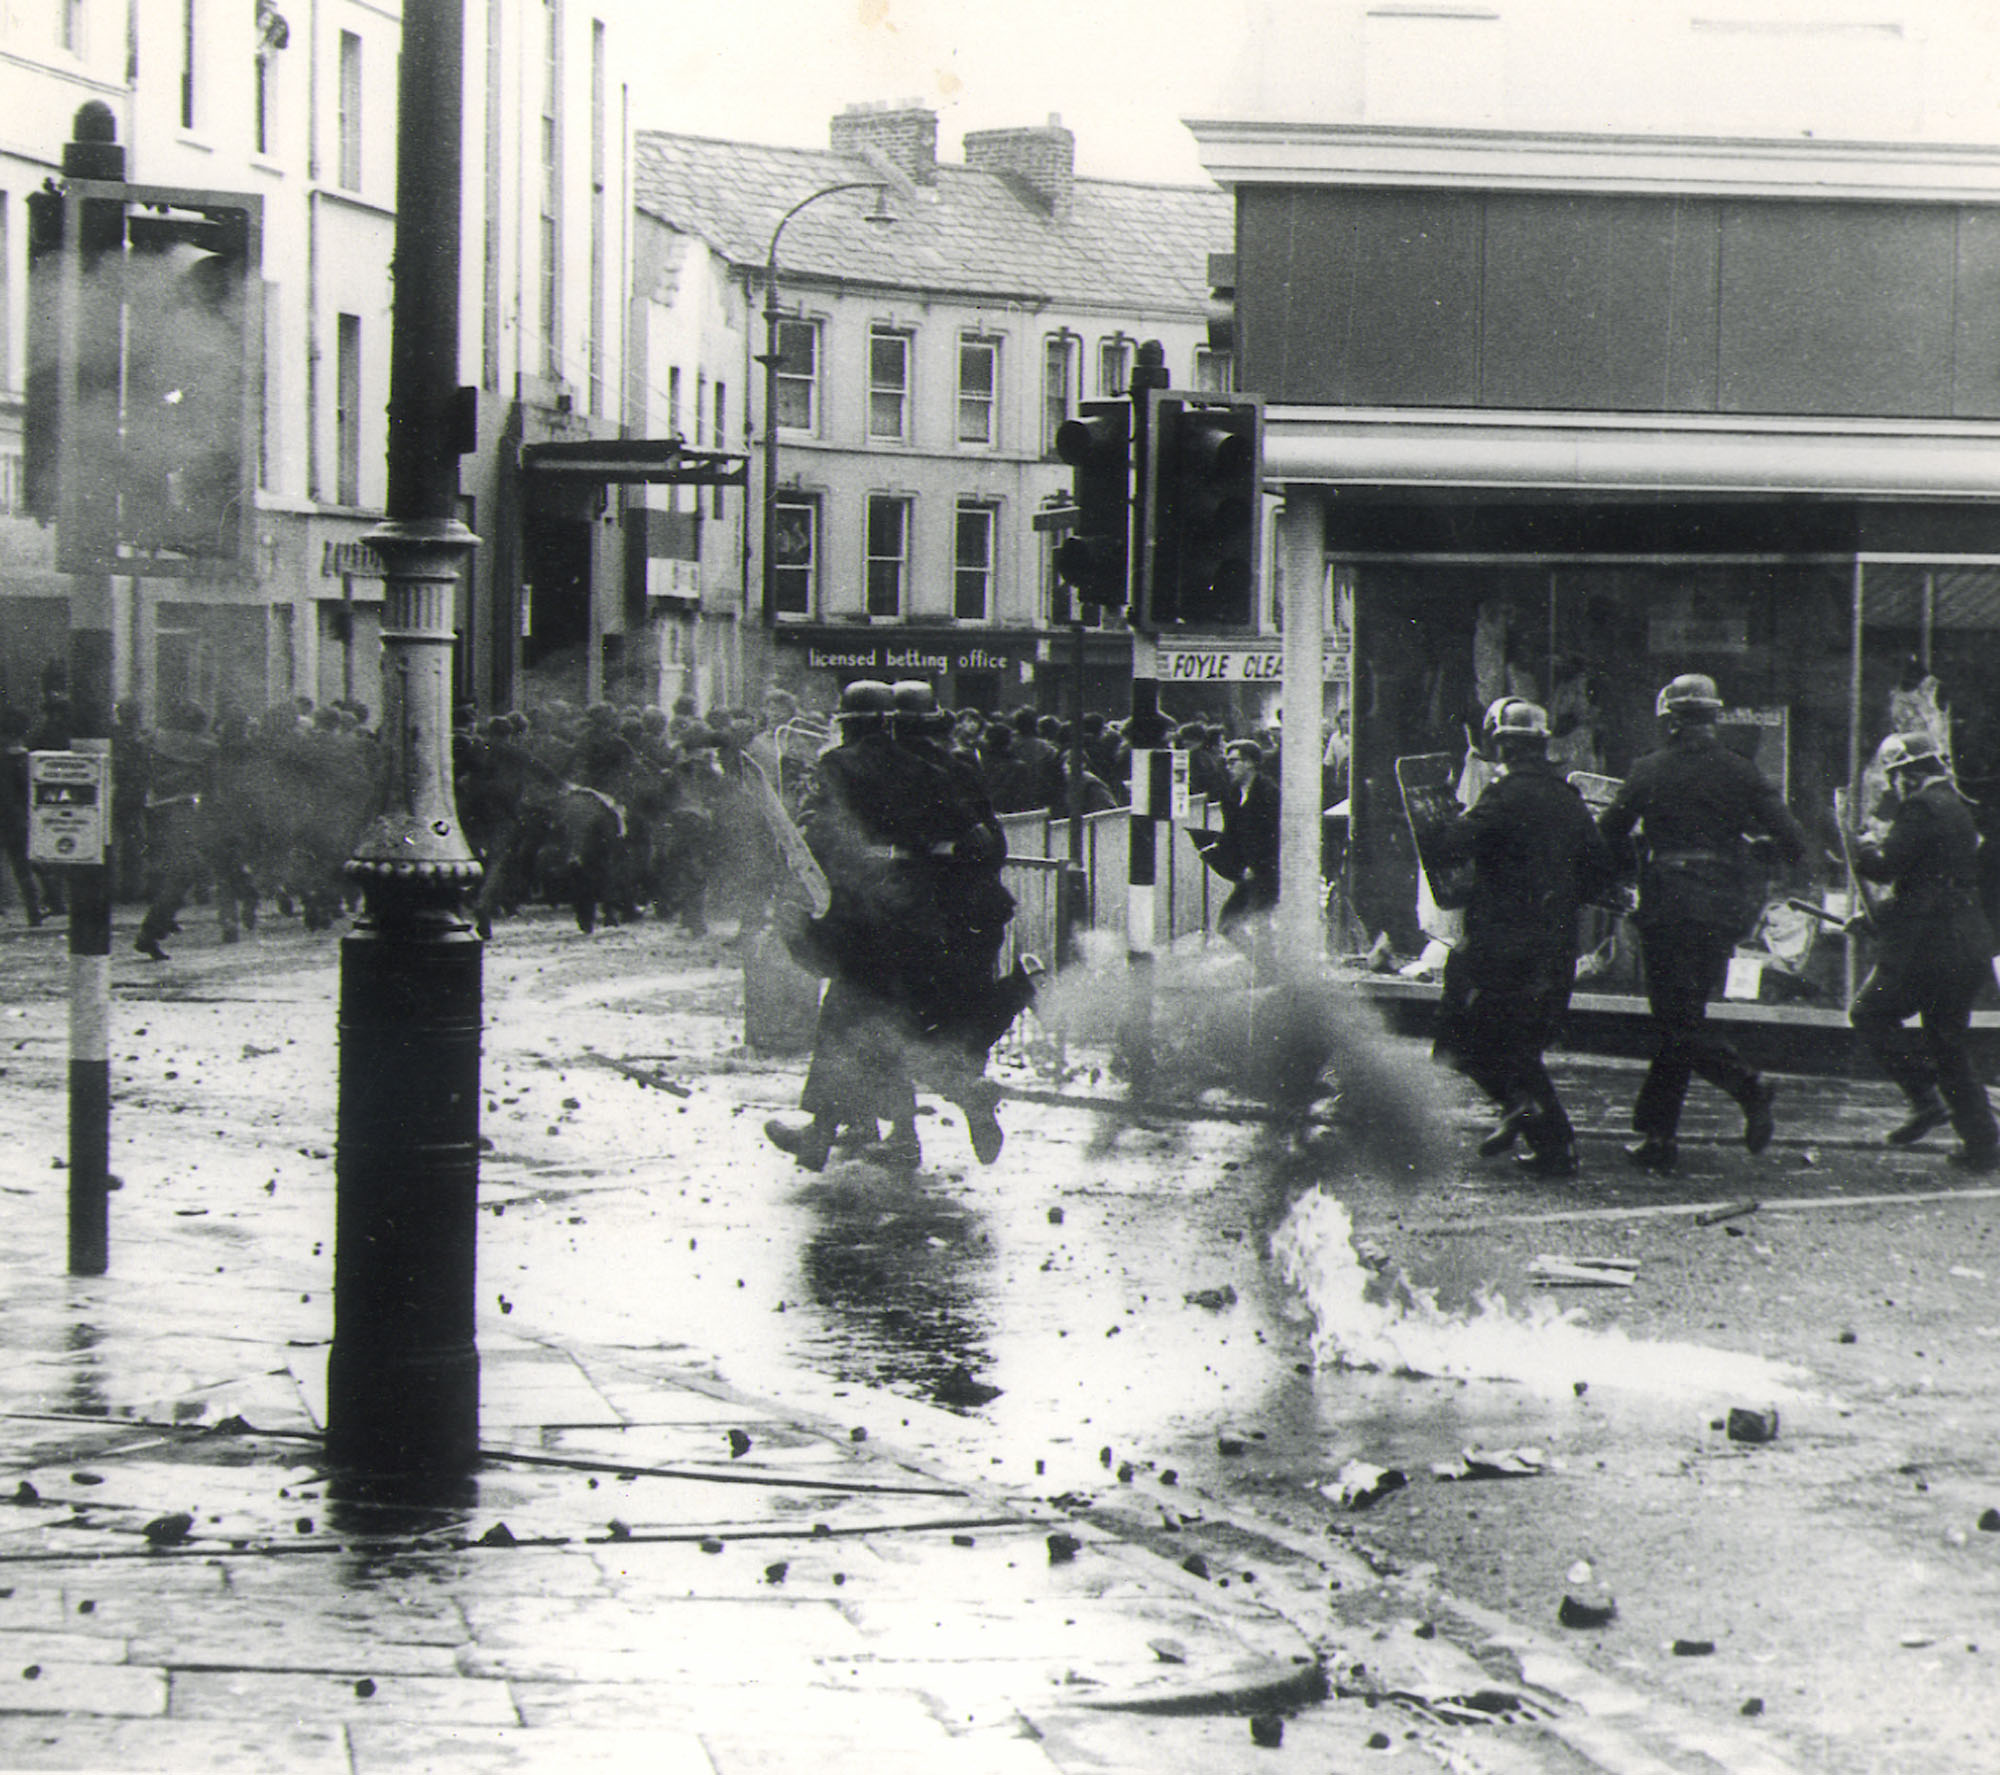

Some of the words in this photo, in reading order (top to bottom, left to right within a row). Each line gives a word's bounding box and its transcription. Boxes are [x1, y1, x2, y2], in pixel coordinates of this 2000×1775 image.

[809, 648, 876, 667] licensed
[886, 648, 948, 675] betting
[958, 648, 1008, 668] office
[1173, 654, 1229, 679] FOYLE
